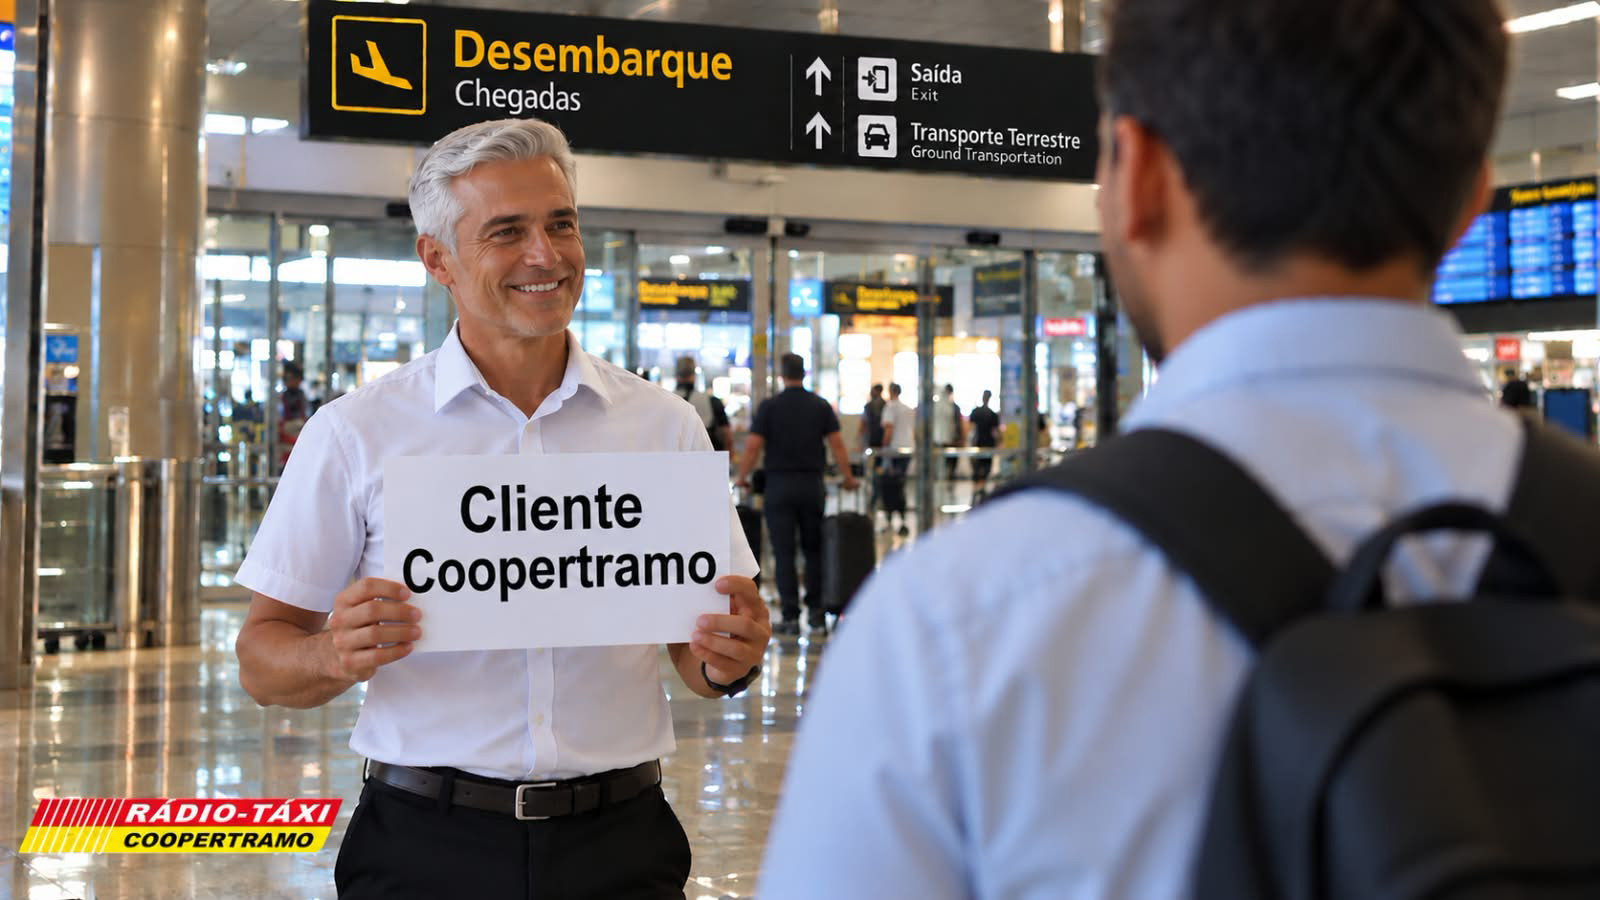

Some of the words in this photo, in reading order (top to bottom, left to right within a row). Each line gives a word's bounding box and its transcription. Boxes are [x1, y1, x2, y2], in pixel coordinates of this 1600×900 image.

[454, 28, 733, 89] Desembarque
[911, 62, 962, 84] Saída
[455, 78, 581, 115] Chegadas
[911, 87, 938, 102] Exit
[910, 122, 1004, 147] Transporte
[1007, 127, 1081, 149] Terrestre
[911, 144, 962, 160] Ground
[964, 147, 1063, 166] Transportation
[460, 484, 643, 534] Cliente
[403, 545, 716, 602] Coopertramo
